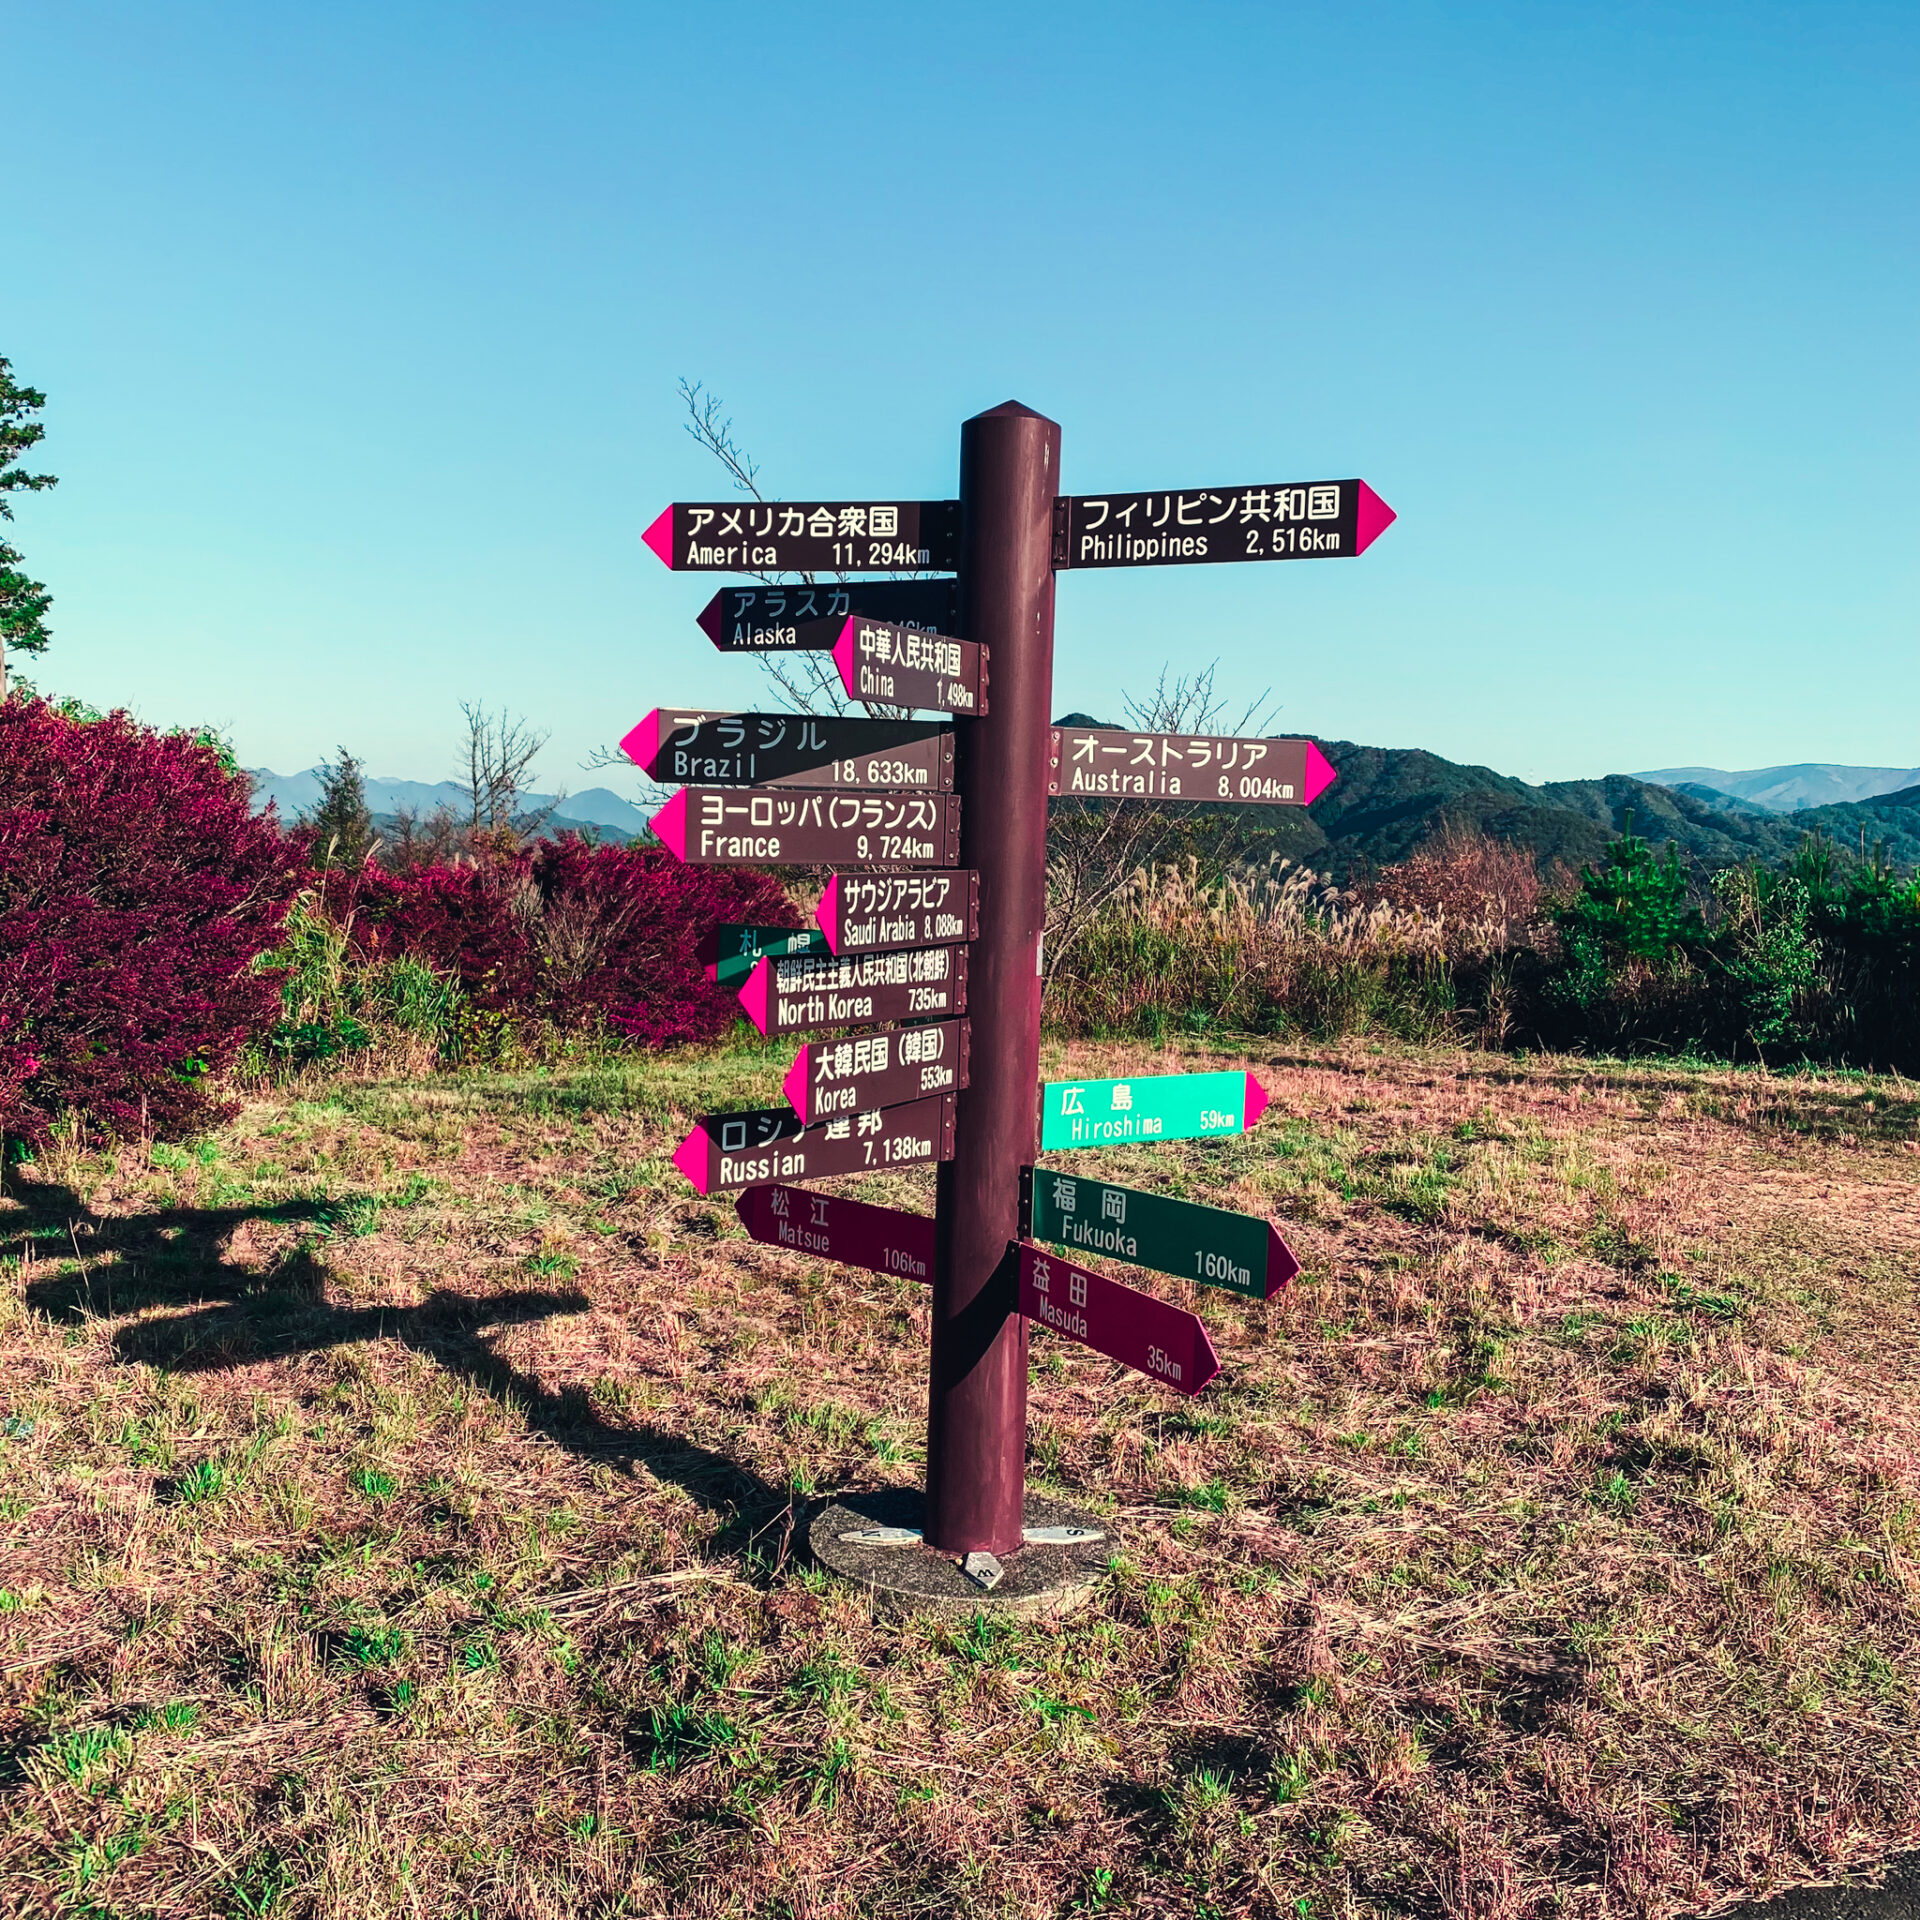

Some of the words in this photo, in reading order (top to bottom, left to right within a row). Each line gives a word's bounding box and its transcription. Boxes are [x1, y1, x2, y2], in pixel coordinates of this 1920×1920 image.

[687, 506, 899, 538] アメリカ合衆国
[1083, 485, 1340, 530] フィリピン共和国
[686, 541, 777, 566] America
[832, 542, 930, 567] 11,294km
[1081, 532, 1208, 561] Philippines
[1246, 528, 1340, 556] 2,516km
[734, 588, 851, 618] アラスカ
[733, 623, 796, 645] Alaska
[859, 625, 961, 677] 中華人民共和国
[860, 664, 894, 698] China
[673, 715, 827, 750] ブラジル
[674, 751, 756, 779] Brazil
[831, 760, 928, 785] 18,633km
[1072, 734, 1267, 770] オーストラリア
[1072, 767, 1181, 795] Australia
[1218, 776, 1294, 799] 8,004km
[701, 830, 780, 858] France
[857, 836, 934, 861] 9,724km
[844, 877, 950, 914] サウジアラビア
[844, 916, 877, 946] Saudi
[879, 915, 915, 944] Arabia
[778, 995, 824, 1026] North
[828, 994, 872, 1020] Korea
[908, 988, 947, 1011] 735km
[815, 1037, 889, 1083] 大韓民国
[815, 1087, 856, 1115] Korea
[921, 1065, 953, 1091] 553km
[1072, 1113, 1162, 1141] Hiroshima
[1200, 1110, 1234, 1130] 59km
[721, 1151, 805, 1184] Russian
[864, 1138, 931, 1165] 7,138km
[779, 1220, 829, 1251] Matsue
[883, 1248, 926, 1276] 106km
[1062, 1215, 1137, 1257] Fukuoka
[1195, 1250, 1250, 1286] 160km
[1039, 1294, 1087, 1339] Masuda
[1147, 1345, 1182, 1381] 35km
